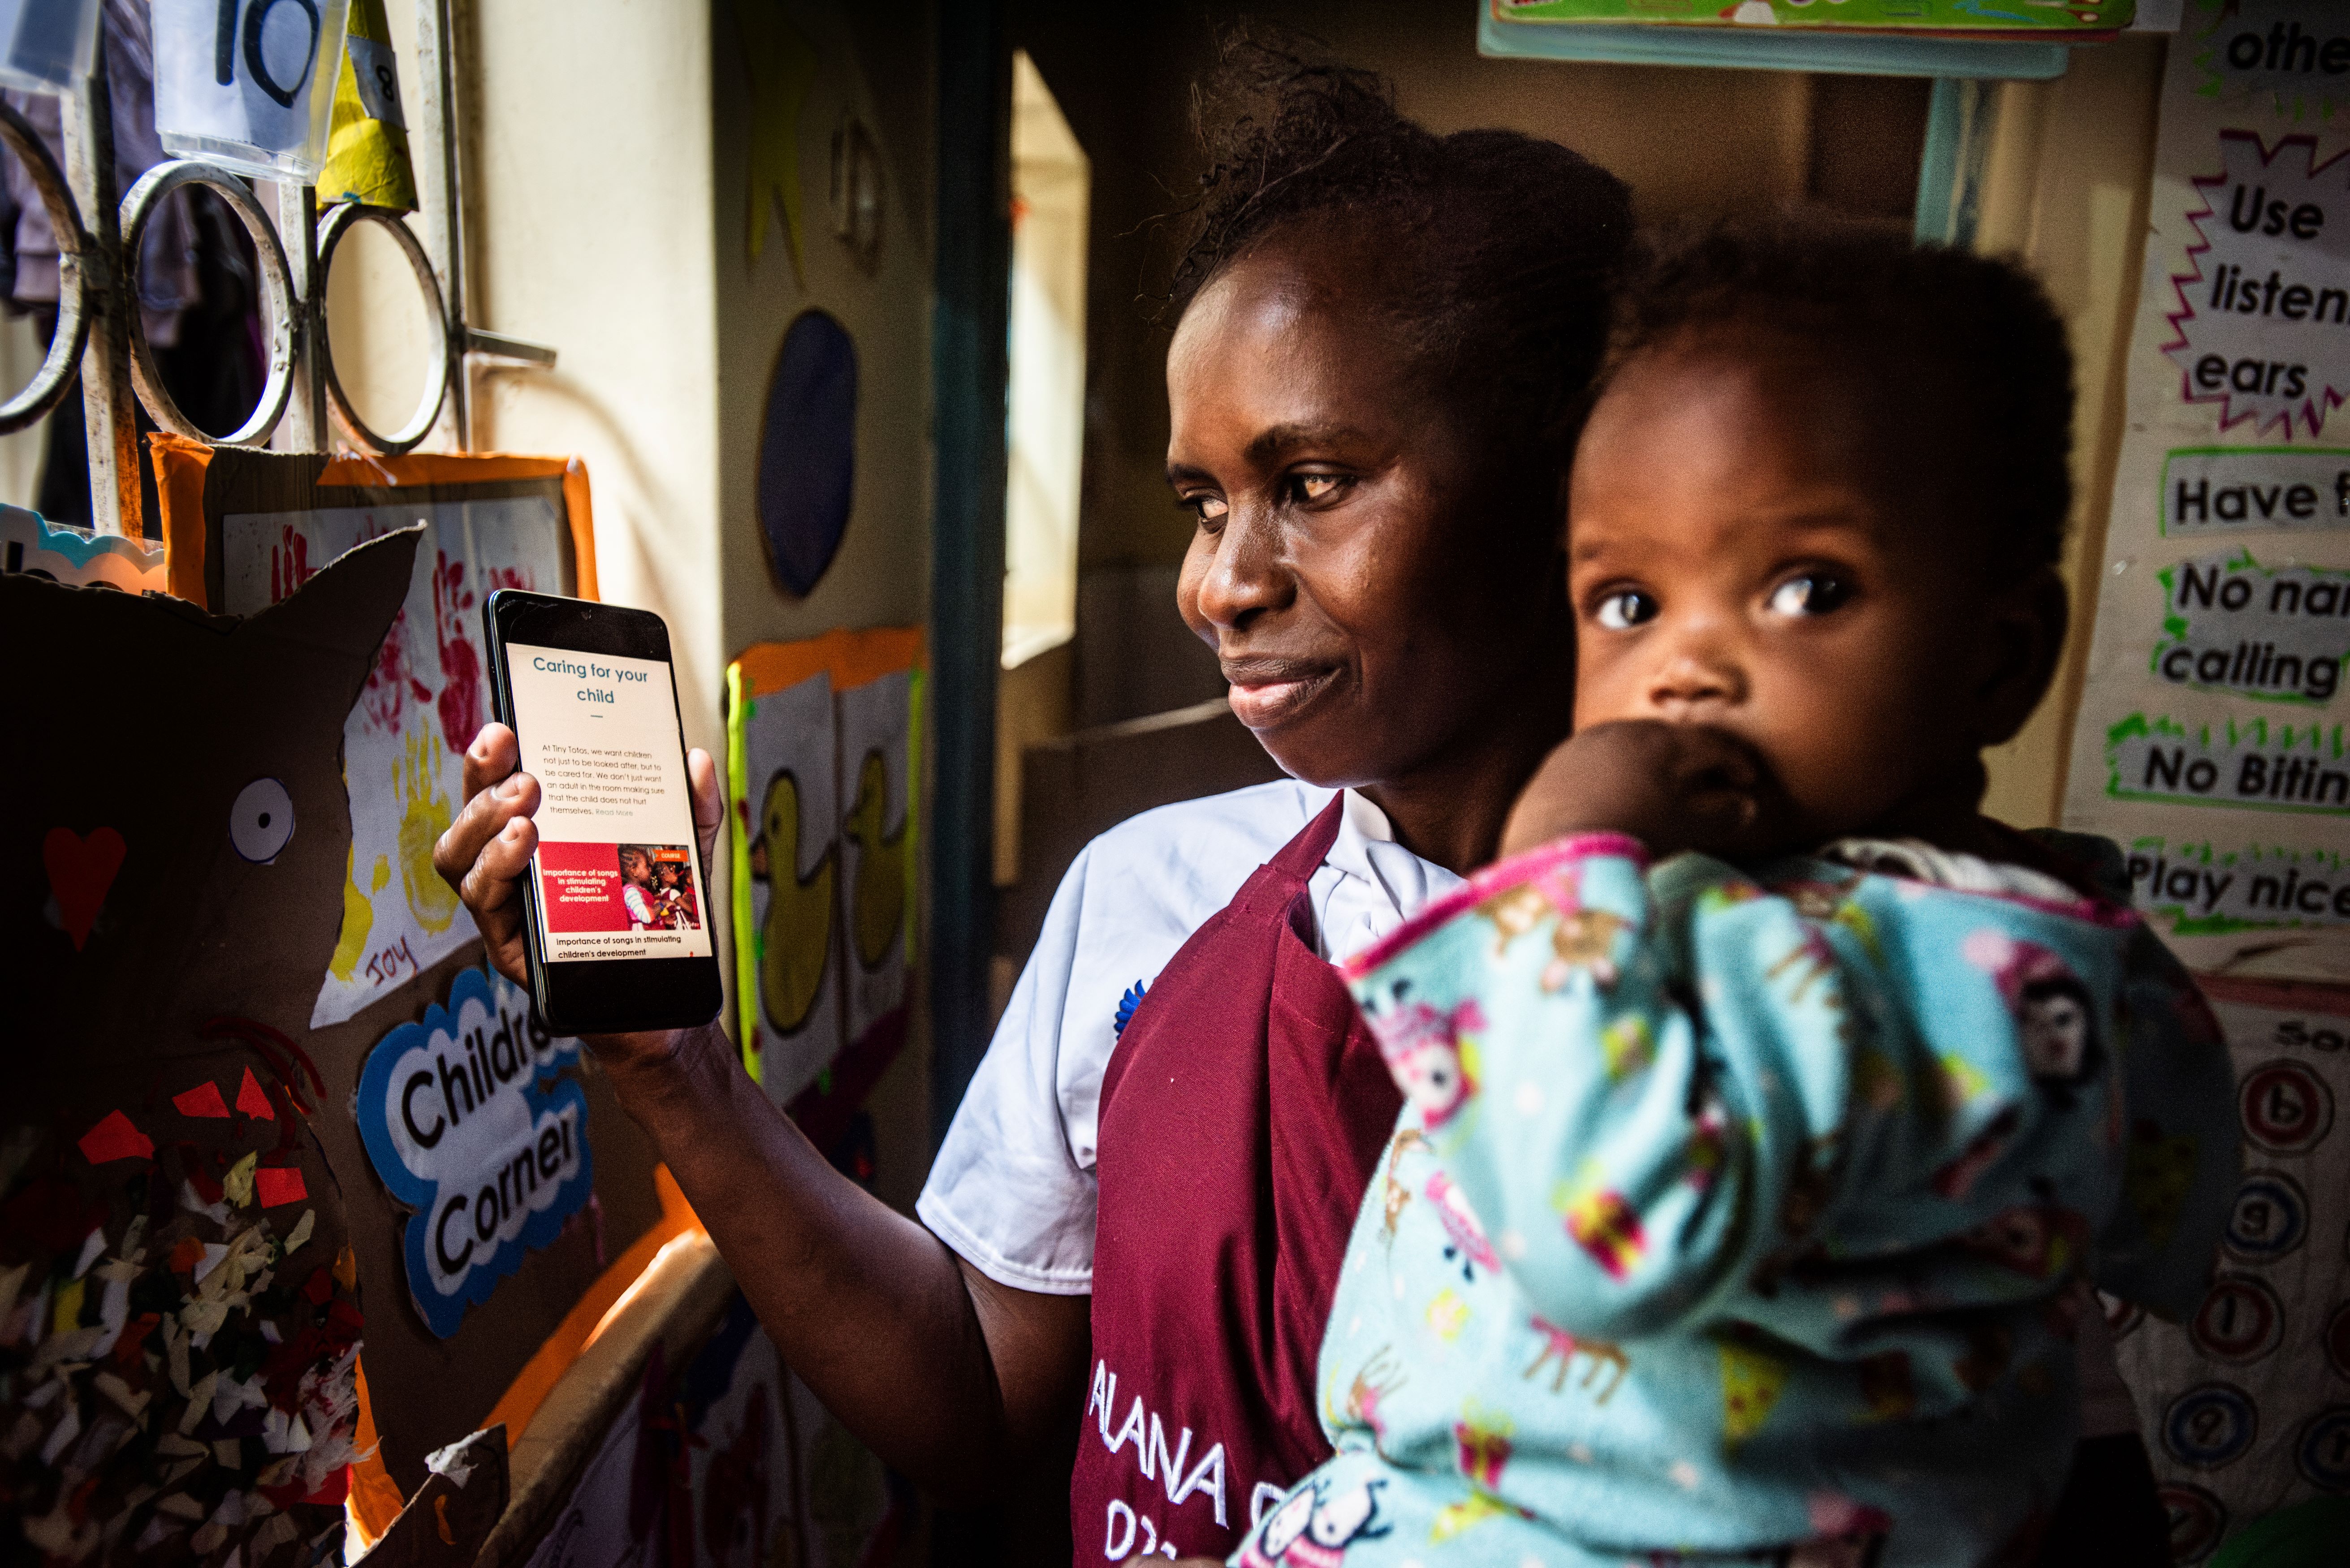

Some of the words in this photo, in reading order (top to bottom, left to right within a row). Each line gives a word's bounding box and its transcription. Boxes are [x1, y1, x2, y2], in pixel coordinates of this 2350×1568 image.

[216, 0, 320, 108] 10
[2229, 22, 2350, 75] othe
[2231, 185, 2324, 239] Use
[2211, 264, 2350, 324] listen
[2196, 354, 2308, 399] ears
[2176, 477, 2318, 524] Have
[2181, 562, 2252, 612] No
[533, 656, 587, 678] Caring
[591, 663, 610, 678] for
[615, 669, 648, 683] your
[2164, 641, 2340, 700] calling
[577, 688, 614, 703] child
[553, 745, 566, 754] Tiny
[558, 758, 570, 766] just
[623, 787, 649, 795] making
[2145, 745, 2219, 794] No
[2239, 753, 2350, 804] Bitin
[550, 806, 594, 814] themselves.
[543, 869, 587, 878] Importance
[597, 870, 618, 878] songs
[566, 878, 606, 887] stimulating
[2129, 855, 2233, 913] Play
[559, 894, 609, 903] development
[557, 937, 600, 947] Importance
[558, 949, 595, 959] children's
[597, 948, 646, 958] development
[402, 1006, 550, 1148] Childr
